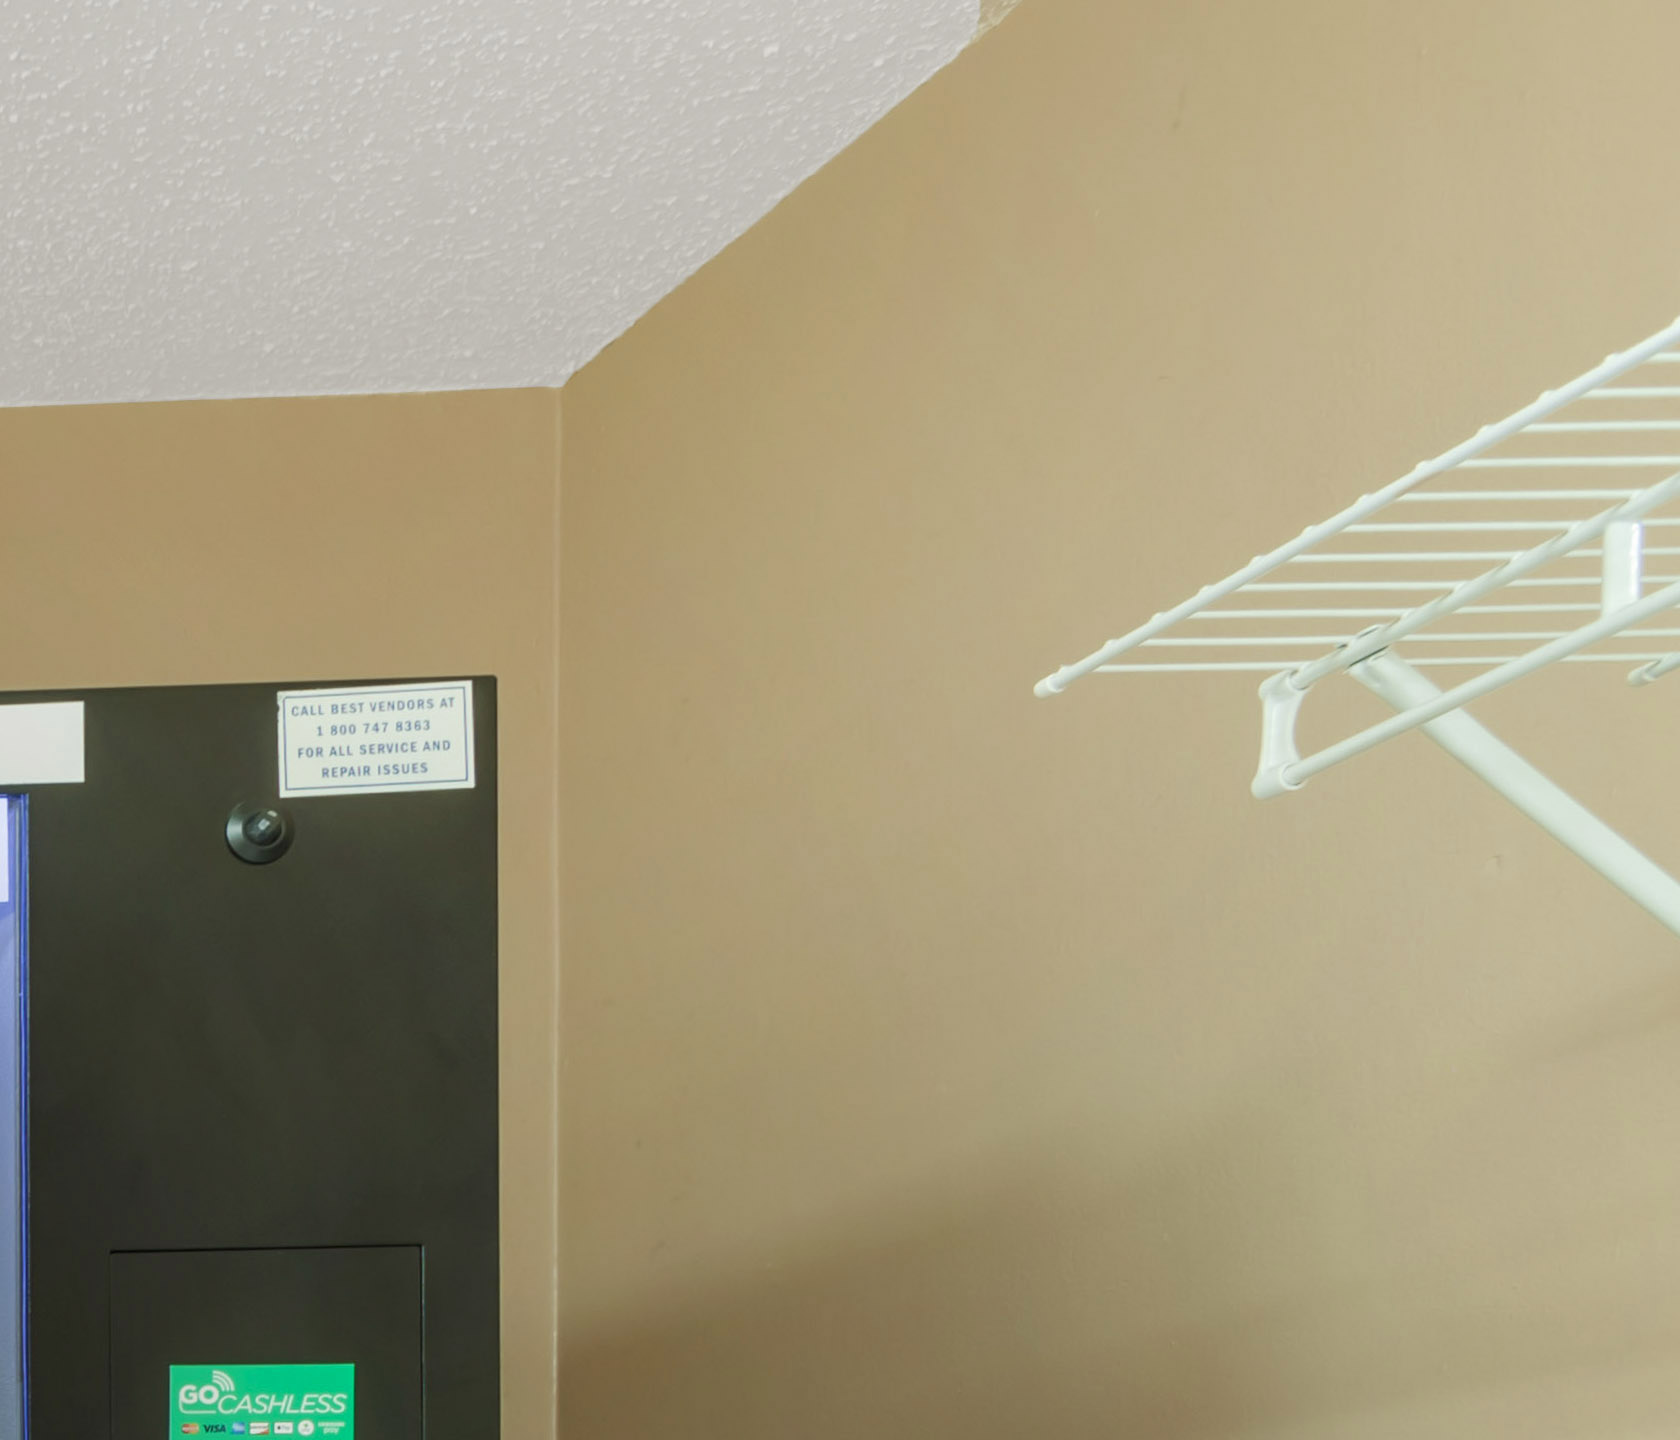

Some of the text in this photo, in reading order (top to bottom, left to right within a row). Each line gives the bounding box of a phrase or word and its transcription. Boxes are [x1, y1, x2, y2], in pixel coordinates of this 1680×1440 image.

[292, 697, 454, 716] CALL BEST VENDORS AT
[317, 720, 430, 736] 1 800 747 8363
[298, 740, 451, 758] FOR ALL SERVICE AND
[322, 763, 427, 778] REPAIR ISSUES
[179, 1385, 347, 1414] GO CASHLESS
